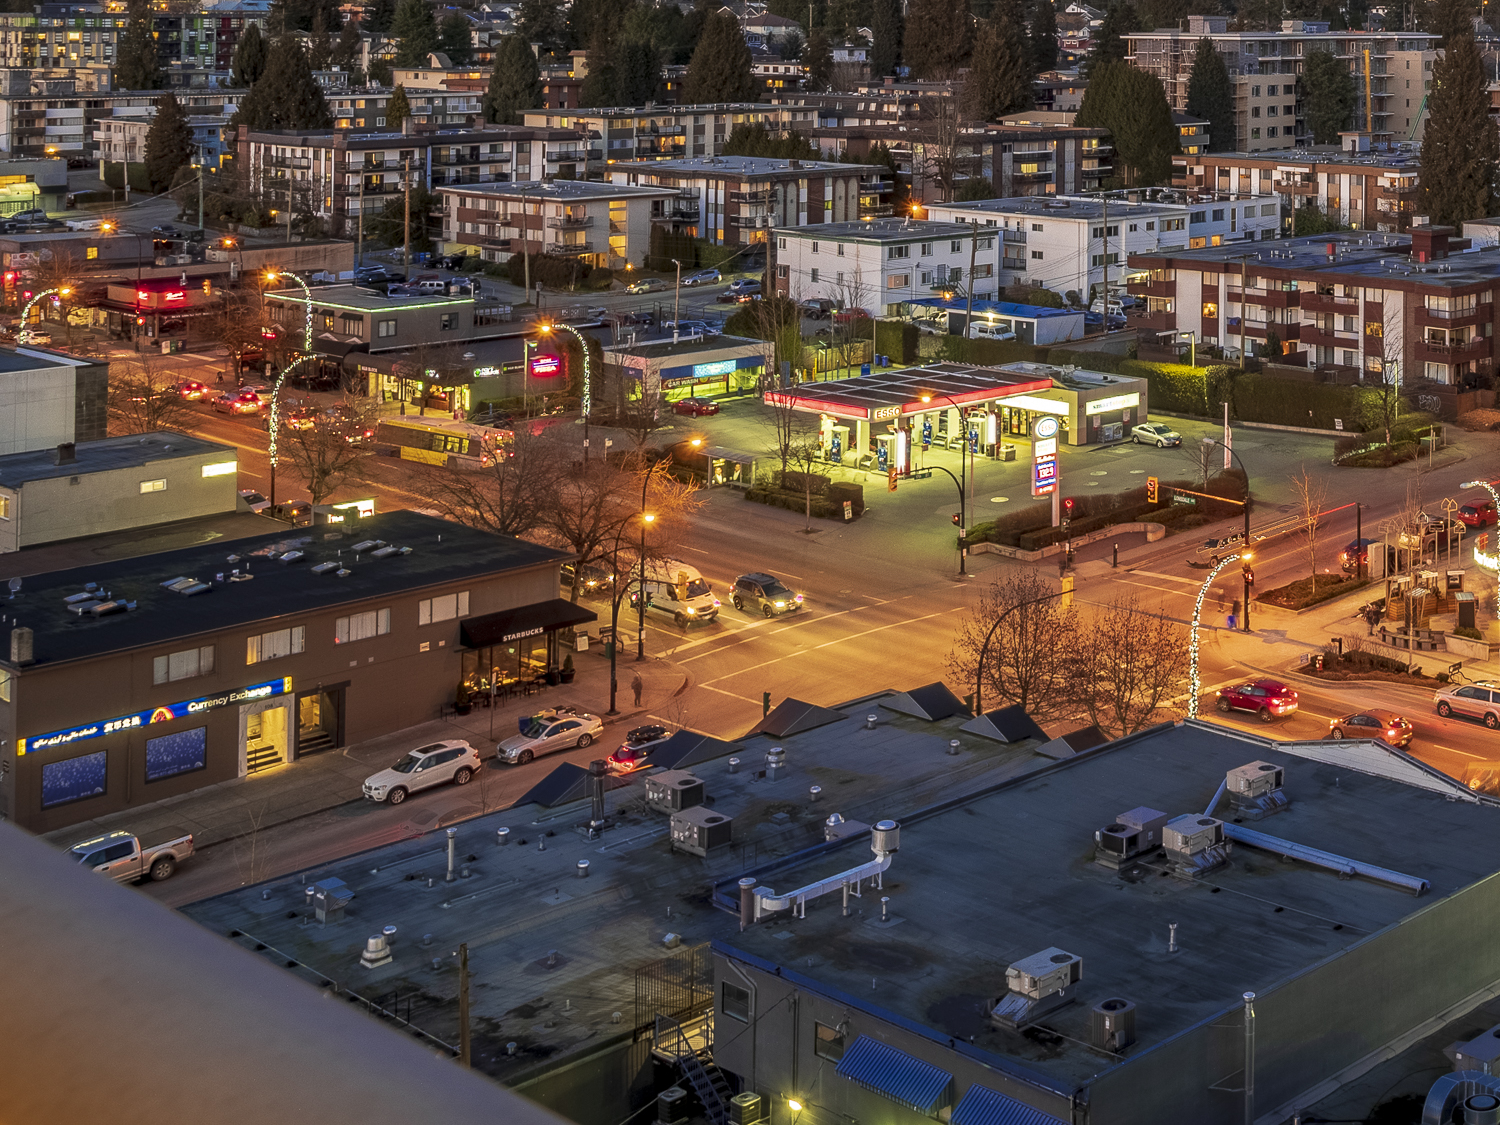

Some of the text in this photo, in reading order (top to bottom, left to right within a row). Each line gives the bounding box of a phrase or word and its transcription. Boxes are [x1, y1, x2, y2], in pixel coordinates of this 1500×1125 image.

[876, 407, 901, 419] ESSO
[502, 627, 544, 642] STARBUCKS
[187, 685, 272, 712] Currency Exchange
